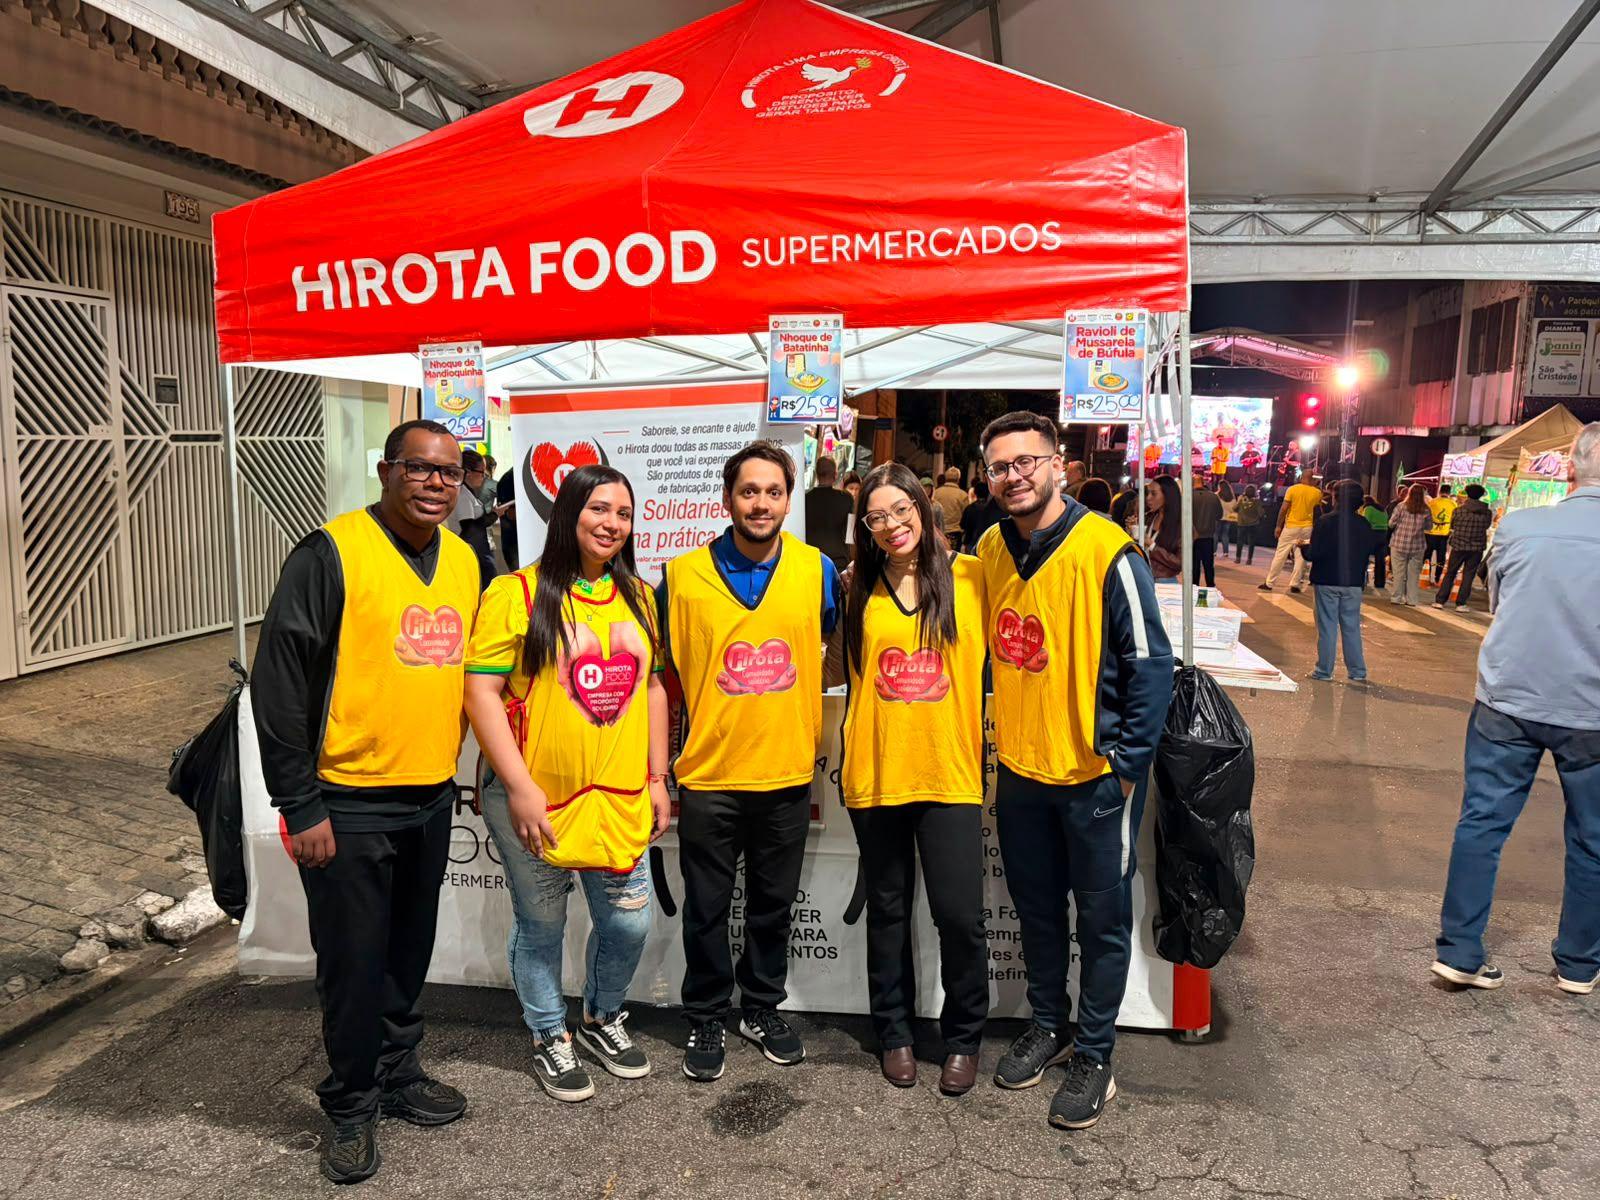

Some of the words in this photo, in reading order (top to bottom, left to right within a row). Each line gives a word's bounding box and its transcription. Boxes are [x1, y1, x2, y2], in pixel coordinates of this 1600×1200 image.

[806, 102, 872, 114] TALENTOS
[292, 247, 515, 312] HIROTA
[529, 229, 717, 295] FOOD
[742, 221, 1063, 267] SUPERMERCADOS
[1076, 326, 1117, 336] Ravioli
[1120, 326, 1136, 336] de
[780, 333, 818, 343] Nhoque
[820, 333, 833, 342] de
[1076, 337, 1135, 348] Mussarela
[783, 343, 829, 352] Batatinha
[1078, 349, 1094, 358] de
[1097, 347, 1135, 358] Búfula
[430, 360, 463, 369] Nhoque
[464, 358, 475, 367] de
[1539, 365, 1555, 373] São
[425, 367, 484, 378] Mandioquinha
[781, 400, 797, 411] R$
[1077, 400, 1094, 410] R$
[680, 426, 691, 435] se
[692, 423, 724, 434] encante
[726, 424, 732, 433] e
[733, 421, 758, 434] ajude.
[617, 445, 624, 454] o
[625, 443, 650, 454] Hirota
[651, 442, 673, 453] doou
[674, 441, 697, 452] todas
[698, 442, 709, 452] as
[710, 440, 742, 450] massas
[646, 457, 661, 469] que
[664, 455, 683, 467] você
[685, 454, 697, 466] vai
[647, 470, 663, 480] São
[664, 468, 701, 481] produtos
[703, 468, 713, 478] de
[657, 484, 668, 494] de
[669, 481, 711, 495] fabricação
[605, 665, 632, 673] HIROTA
[584, 669, 597, 684] H
[606, 672, 631, 682] FOOD
